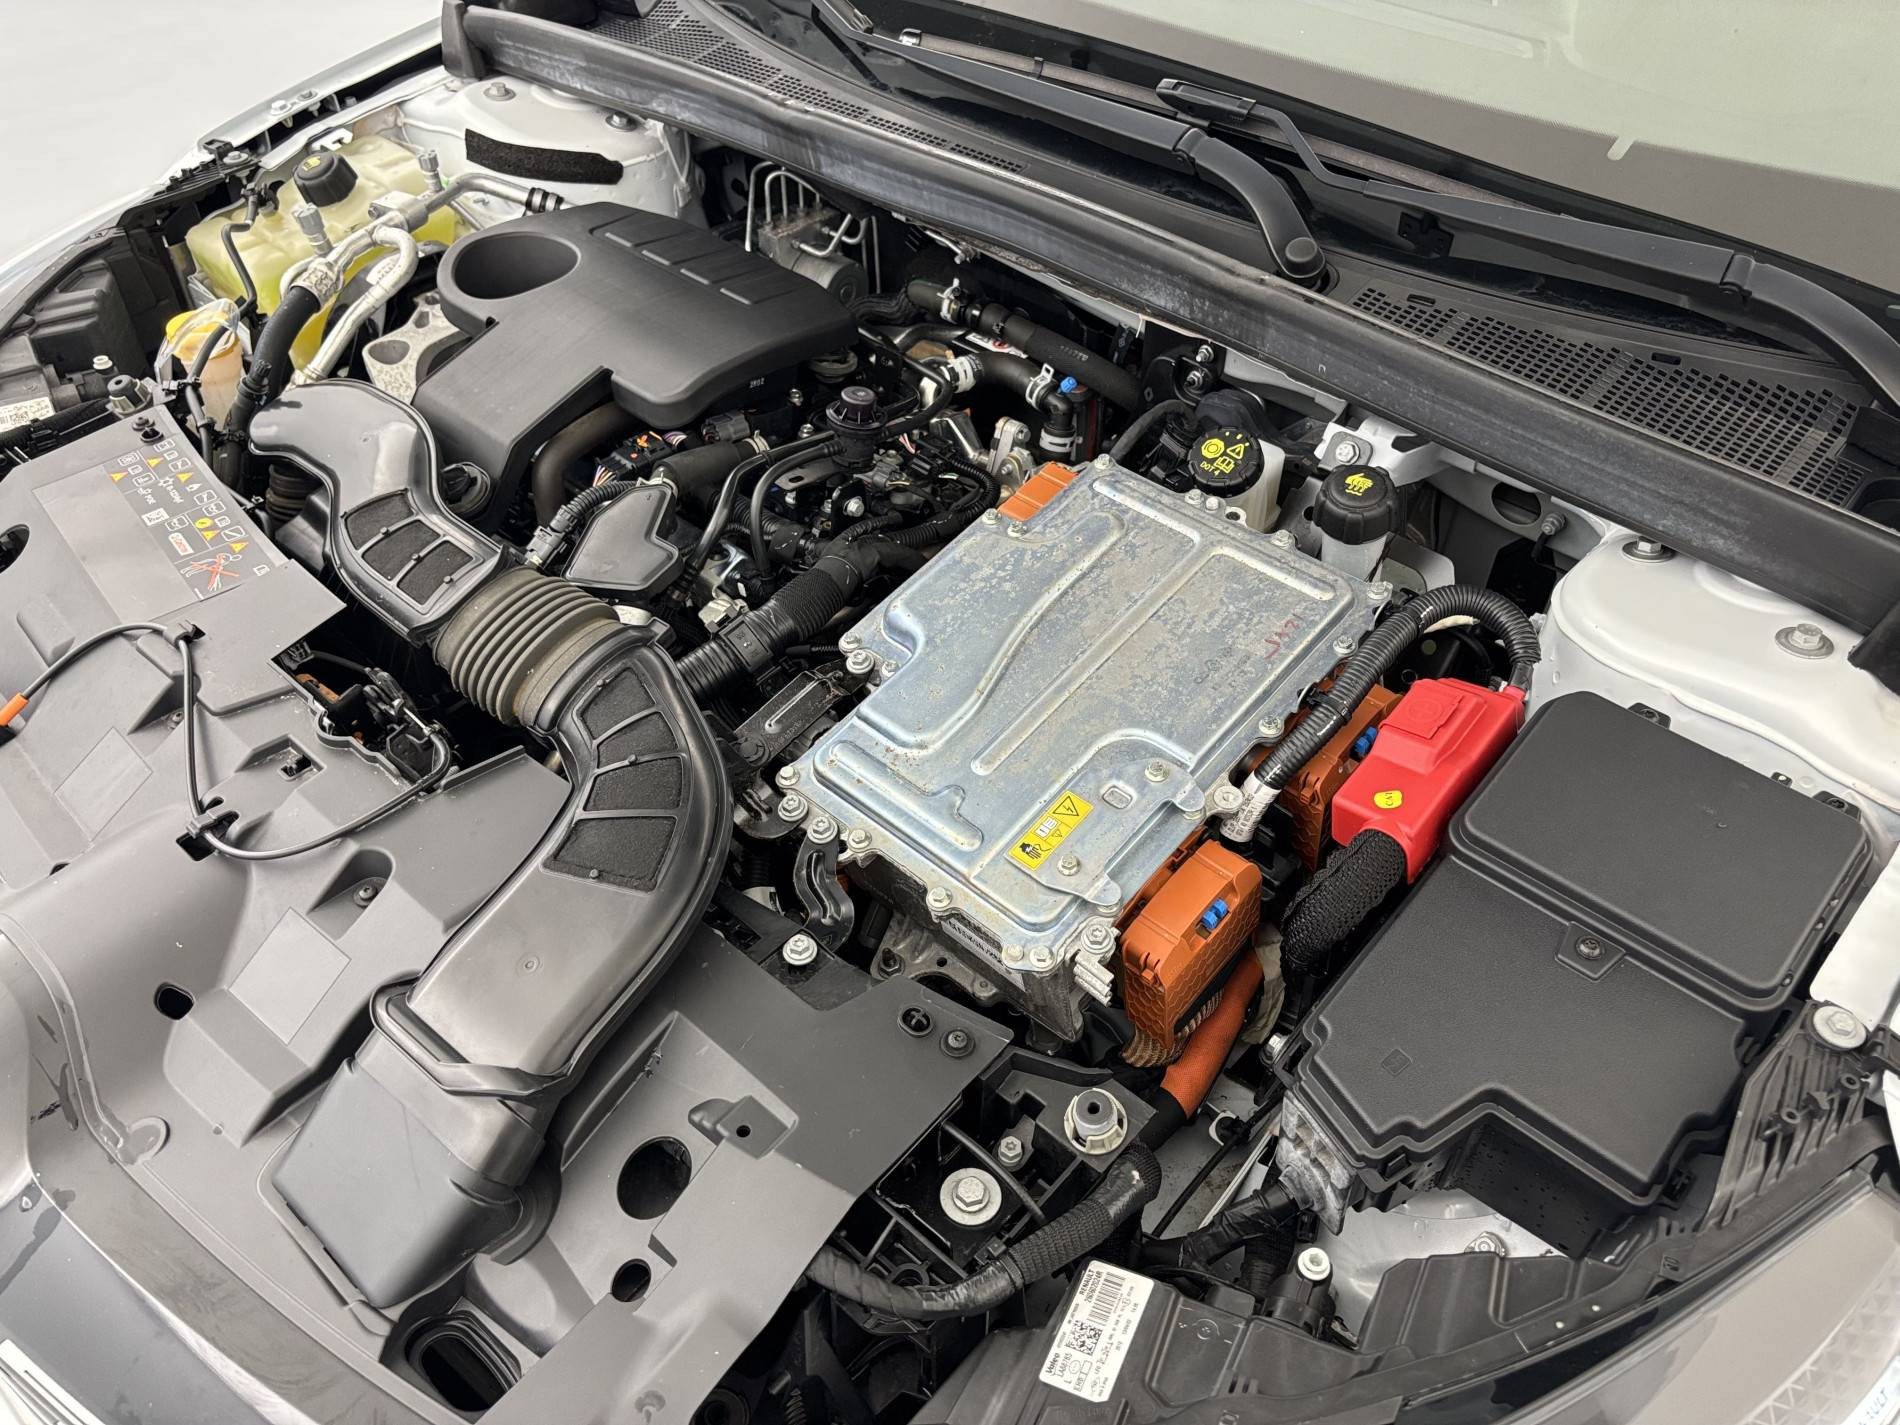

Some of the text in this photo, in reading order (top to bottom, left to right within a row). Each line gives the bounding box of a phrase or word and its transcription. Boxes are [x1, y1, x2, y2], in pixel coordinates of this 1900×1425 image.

[1200, 461, 1215, 472] DOT
[1079, 1268, 1096, 1295] RENAULT
[1045, 1352, 1060, 1374] Valeo
